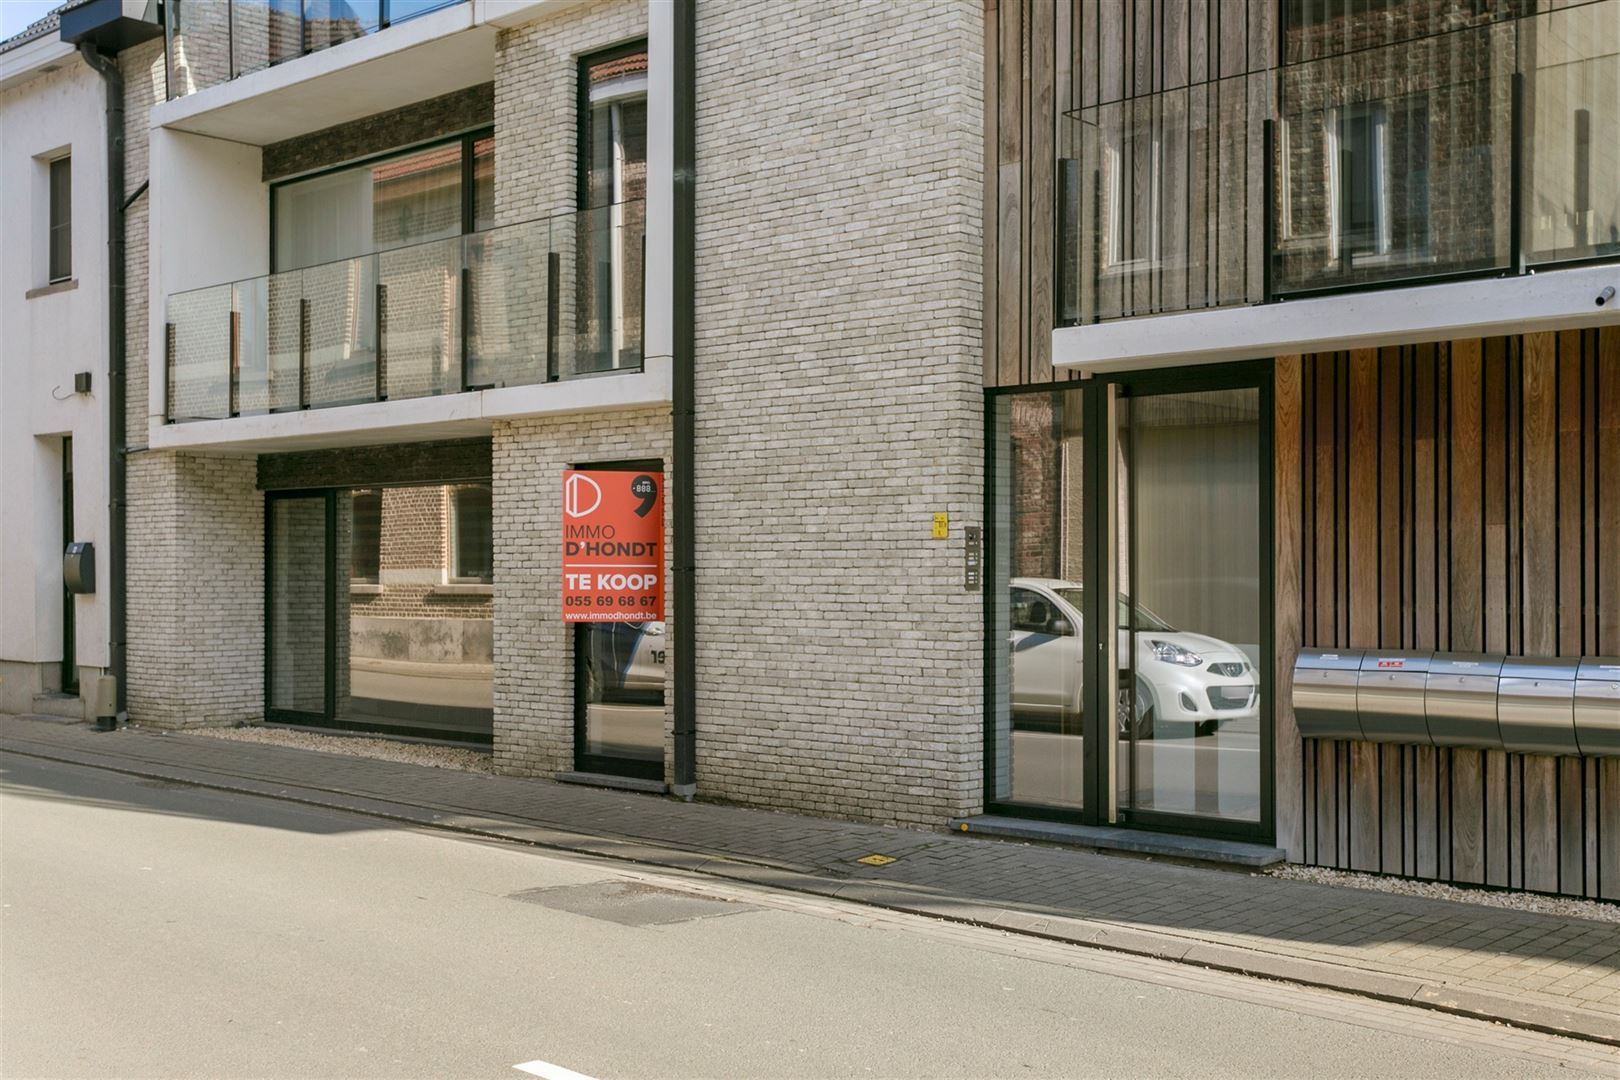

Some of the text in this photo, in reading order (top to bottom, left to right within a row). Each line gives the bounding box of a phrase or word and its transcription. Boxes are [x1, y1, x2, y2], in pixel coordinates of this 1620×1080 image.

[565, 525, 616, 540] IMMO
[565, 573, 657, 591] TE KOOP
[565, 596, 657, 607] 055 69 68 67
[565, 611, 657, 621] www.immodhondt.be
